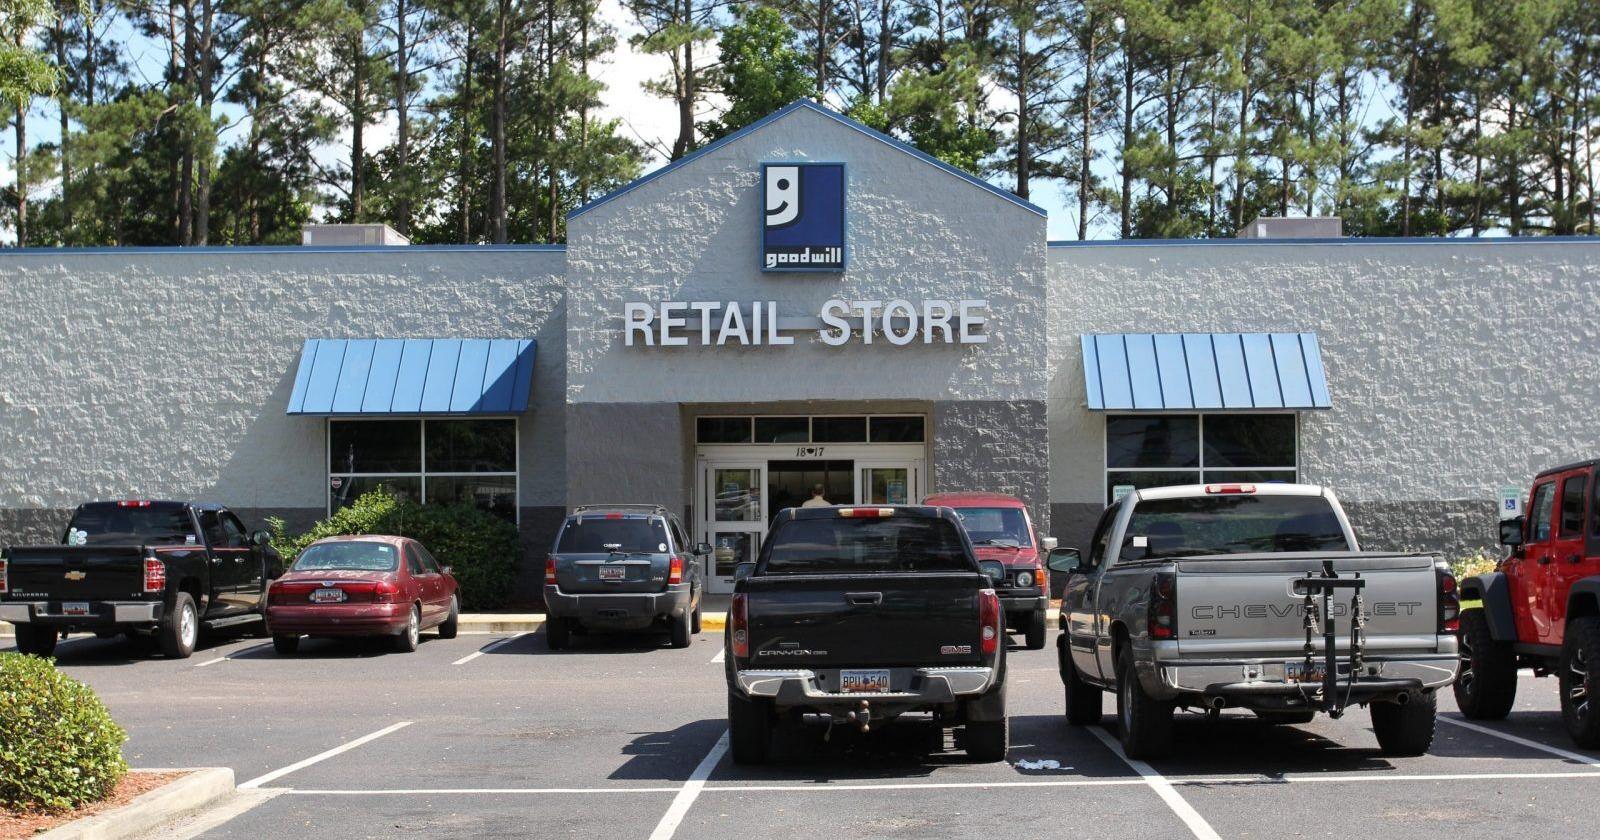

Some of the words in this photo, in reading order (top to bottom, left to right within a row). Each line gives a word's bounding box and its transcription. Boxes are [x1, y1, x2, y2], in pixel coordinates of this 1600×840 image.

[766, 247, 842, 268] goodwill
[624, 301, 794, 347] RETAIL
[819, 300, 989, 346] STORE
[1191, 602, 1422, 619] CHEVOET
[940, 645, 972, 655] GMC
